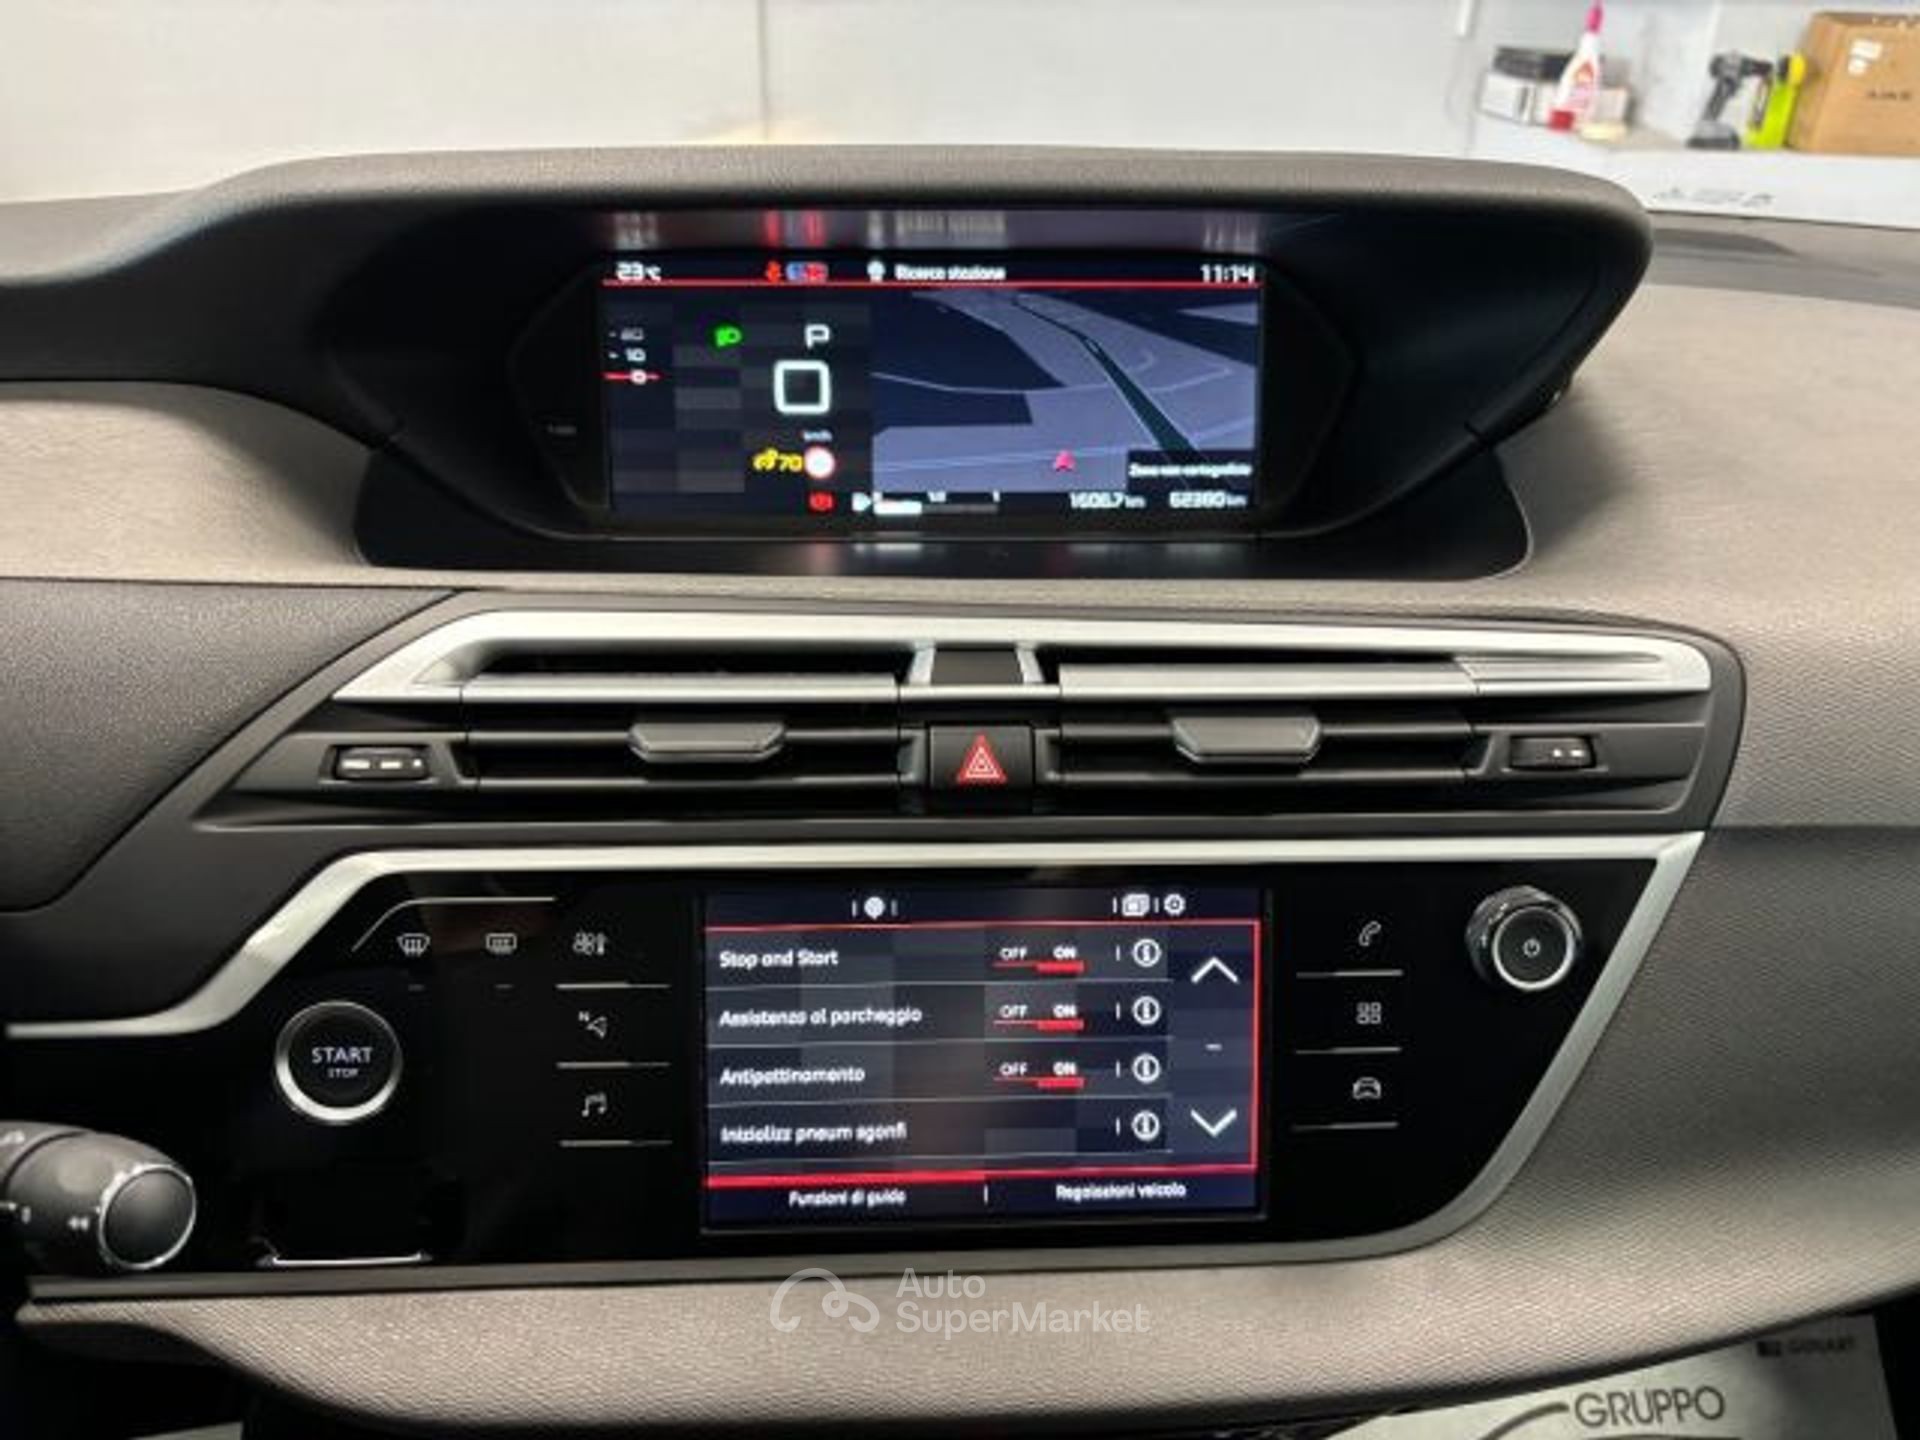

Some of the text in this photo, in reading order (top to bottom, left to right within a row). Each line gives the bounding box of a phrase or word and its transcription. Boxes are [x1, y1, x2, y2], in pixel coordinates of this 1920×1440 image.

[1200, 264, 1255, 283] 11:14
[804, 324, 830, 348] P
[719, 949, 839, 970] Stop and Start
[999, 945, 1078, 961] OFF ON
[719, 1005, 923, 1027] Assistenza al parcheggio
[999, 1004, 1078, 1019] OFF ON
[311, 1045, 373, 1065] START
[327, 1067, 360, 1079] STOP
[719, 1066, 866, 1088] Antipattinamento
[999, 1061, 1078, 1076] OFF ON
[1574, 1386, 1725, 1430] GRUPPO
